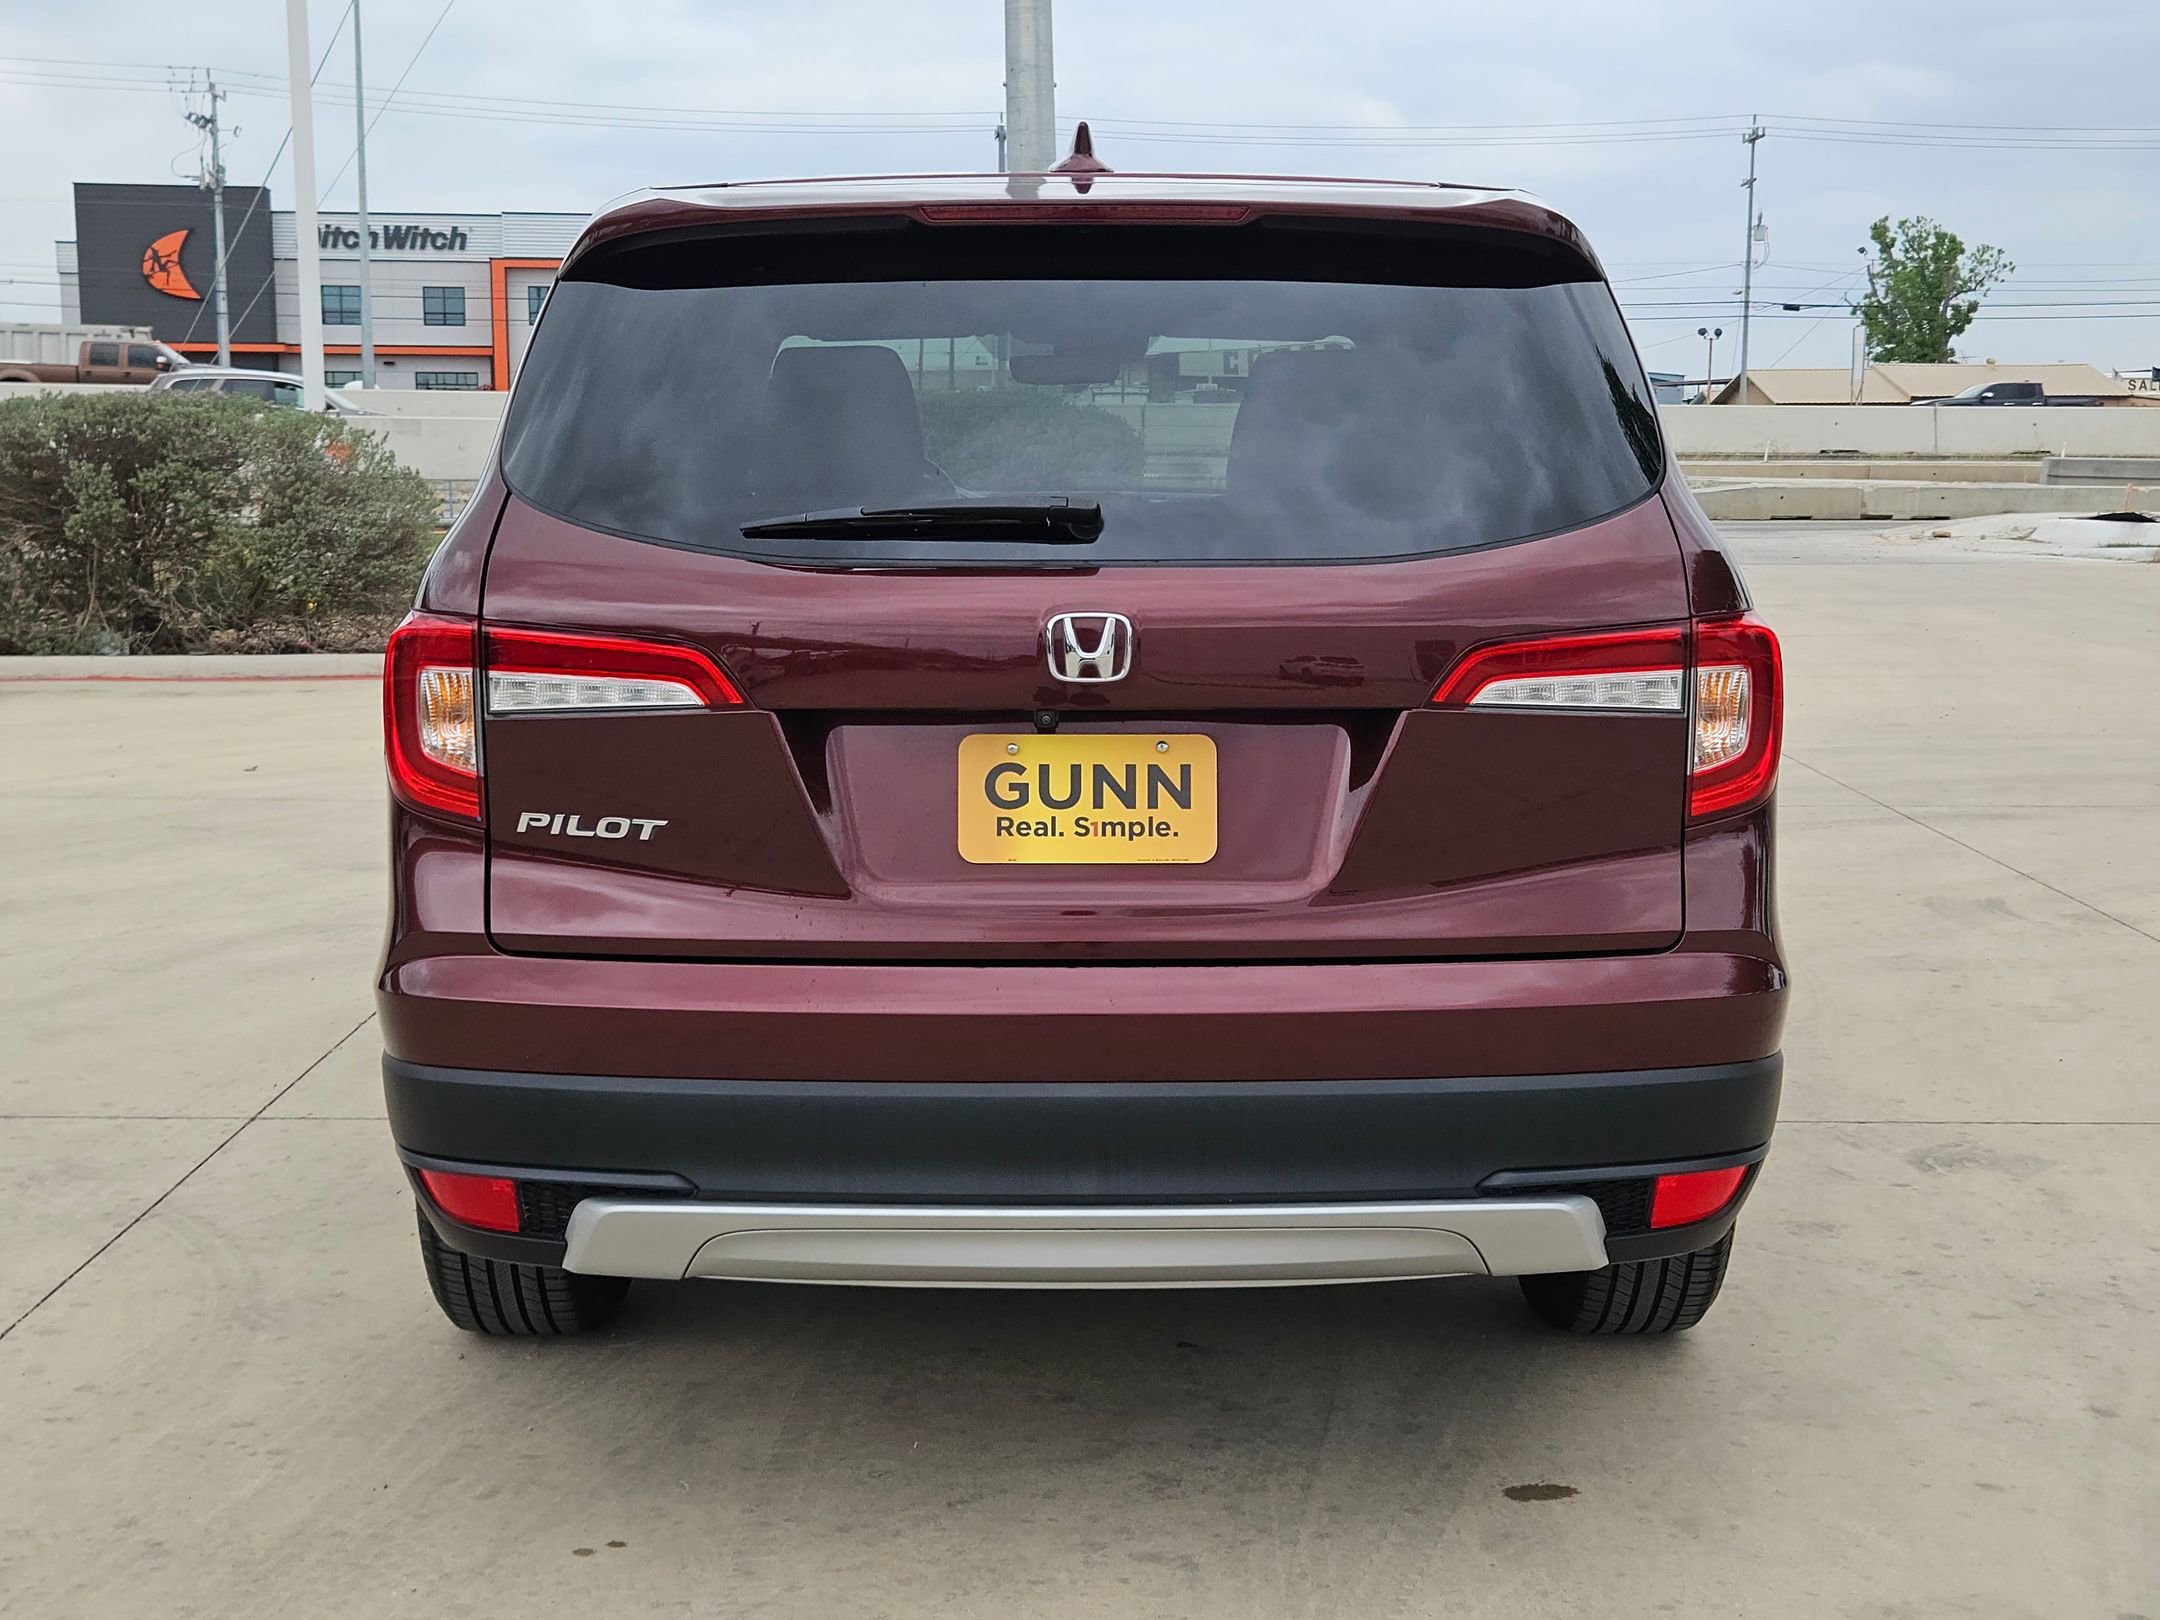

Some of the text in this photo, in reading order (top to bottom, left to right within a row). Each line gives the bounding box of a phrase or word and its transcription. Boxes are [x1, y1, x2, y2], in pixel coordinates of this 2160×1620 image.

[318, 224, 467, 250] itch Witch
[2128, 379, 2160, 391] SAL
[984, 762, 1192, 811] GUNN
[516, 812, 669, 841] PILOT
[996, 816, 1065, 837] Real.
